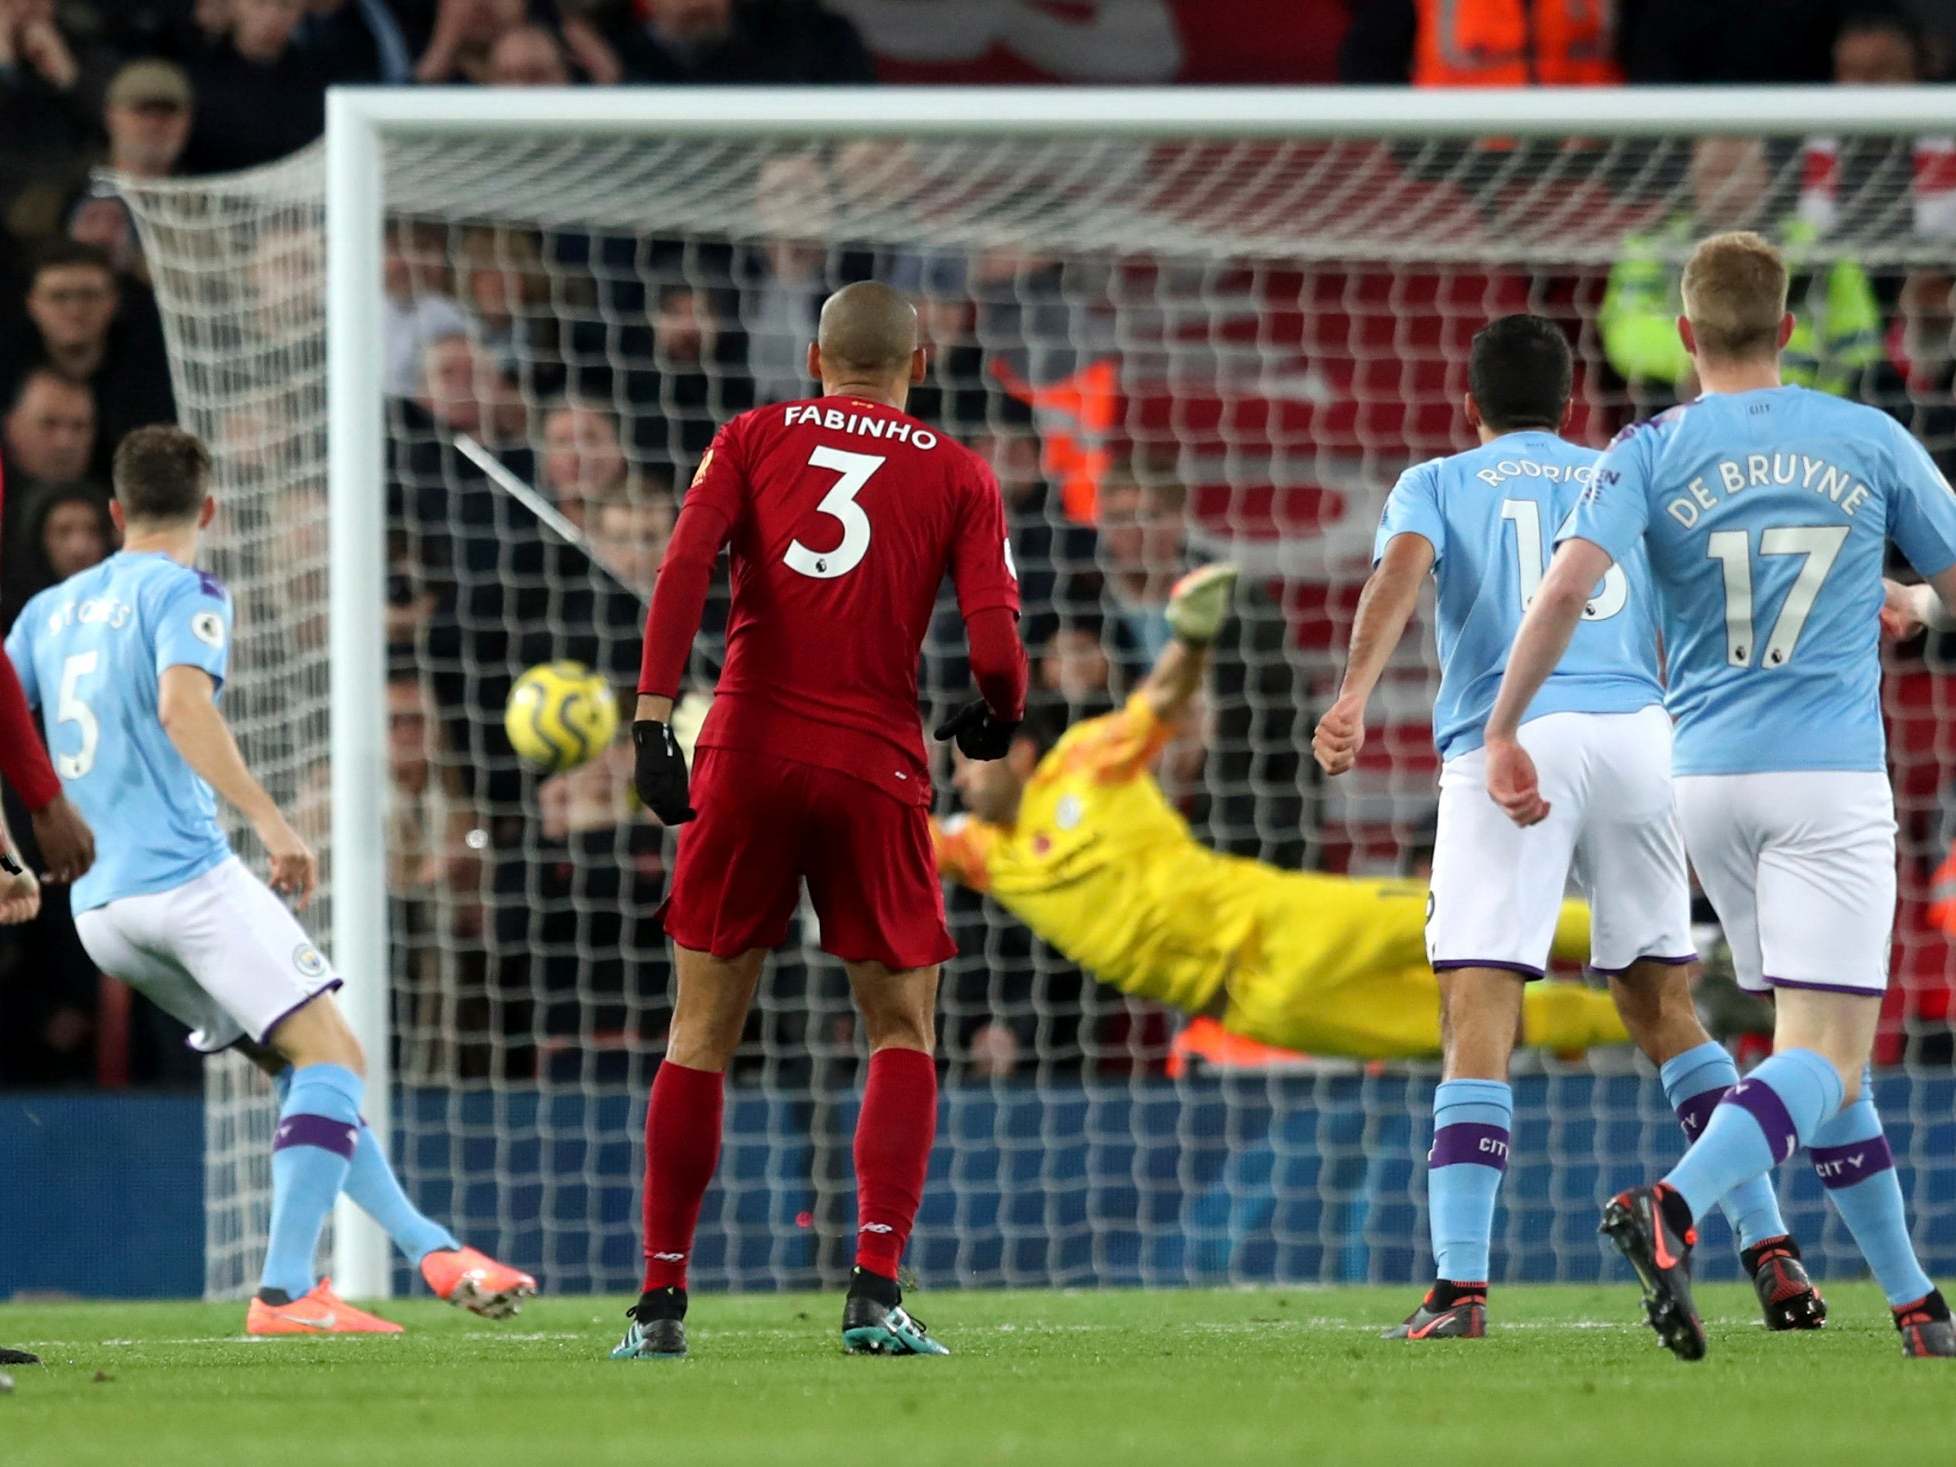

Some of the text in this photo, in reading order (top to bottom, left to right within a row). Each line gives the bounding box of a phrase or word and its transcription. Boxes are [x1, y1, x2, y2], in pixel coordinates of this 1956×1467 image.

[784, 405, 938, 450] FABINHO
[783, 444, 887, 579] 3
[1476, 459, 1595, 488] RODRIG
[1666, 476, 1719, 529] DE
[1718, 453, 1870, 516] BRUYNE
[1706, 524, 1851, 670] 17
[57, 650, 99, 781] 5
[1815, 1152, 1864, 1177] CITY
